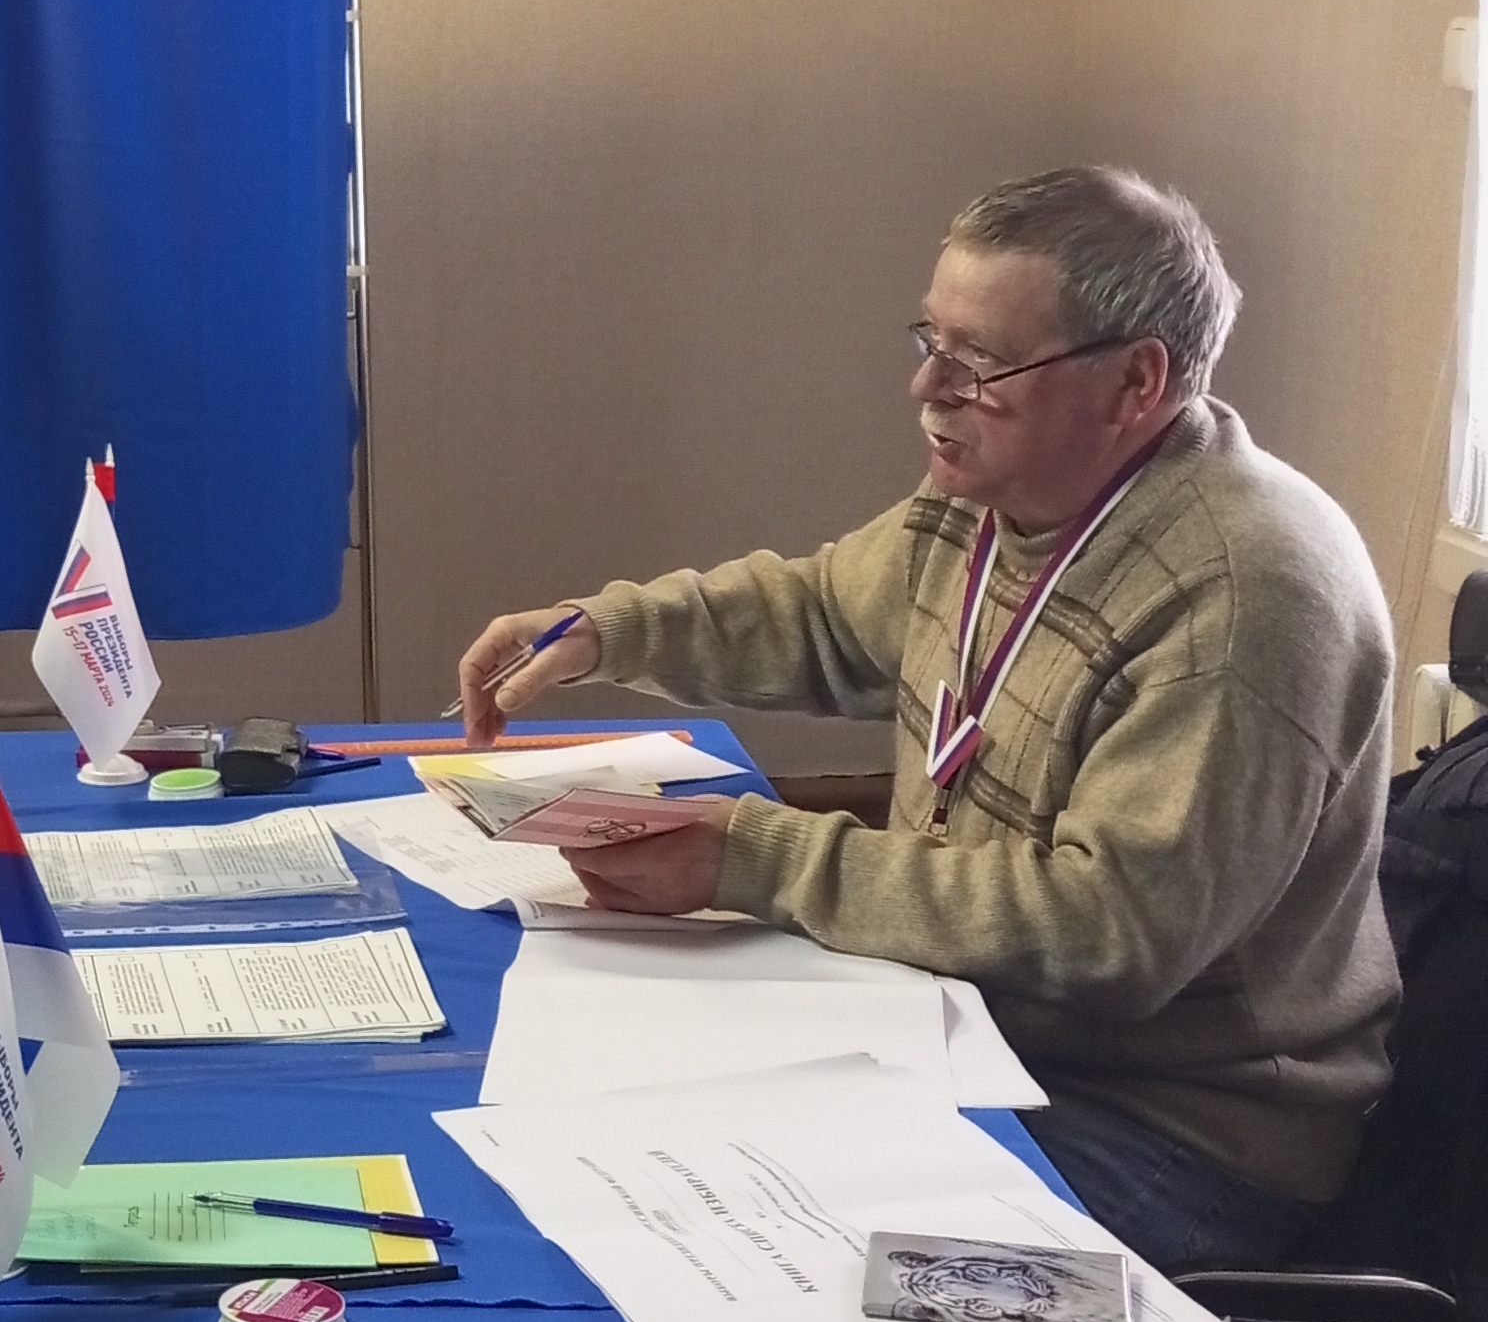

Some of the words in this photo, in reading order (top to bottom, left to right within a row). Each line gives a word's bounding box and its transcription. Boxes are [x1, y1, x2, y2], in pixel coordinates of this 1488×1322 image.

[78, 621, 114, 673] РОССИИ
[96, 618, 132, 699] ПРЕЗИДЕНТА
[110, 614, 134, 671] ВЫБОРЫ
[80, 652, 105, 685] МАРТА
[99, 685, 115, 707] 2024
[646, 1150, 730, 1215] ИЗБИРАТЕЛЕЙ
[772, 1253, 820, 1293] КНИГА
